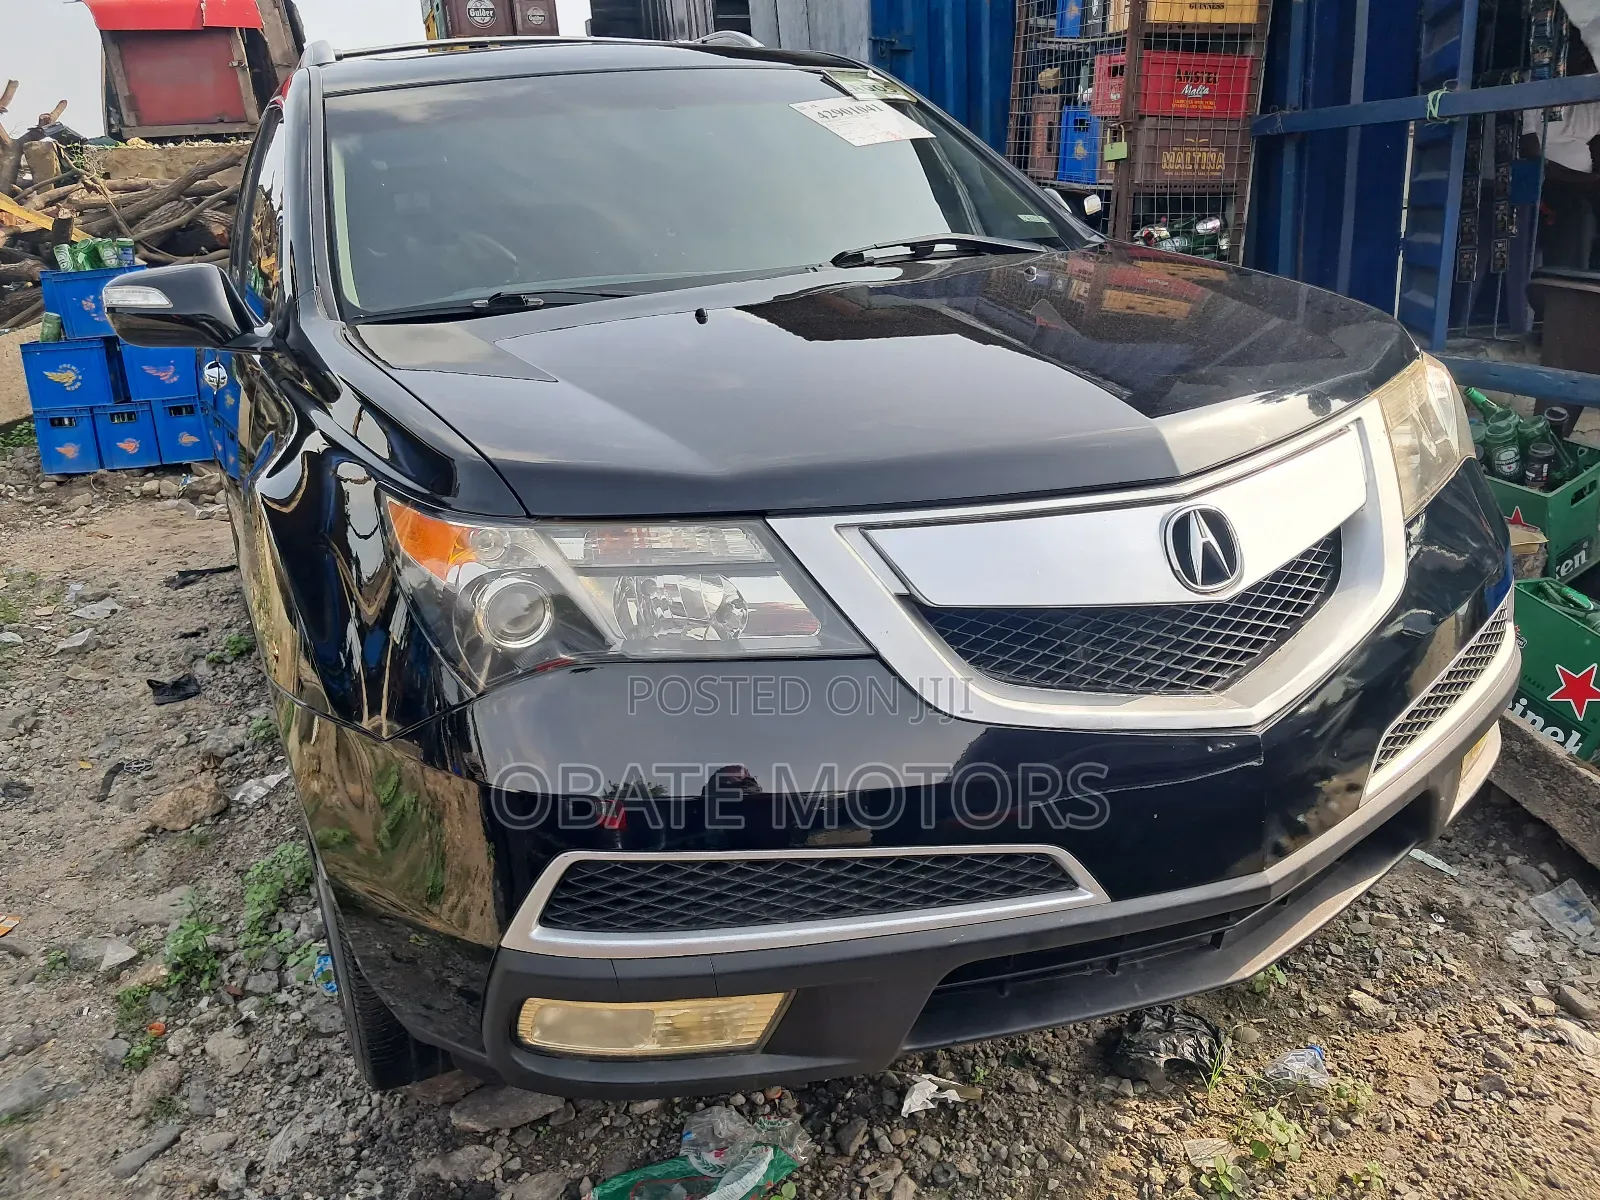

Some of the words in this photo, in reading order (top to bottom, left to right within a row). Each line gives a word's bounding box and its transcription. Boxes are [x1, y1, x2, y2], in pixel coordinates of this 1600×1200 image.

[469, 8, 494, 17] Gulder
[1189, 2, 1225, 10] GUINNESS
[1174, 68, 1219, 85] AMSTEL
[1181, 84, 1210, 96] Malta
[817, 103, 884, 120] 42901041
[1161, 151, 1226, 169] MALTINA
[1507, 697, 1583, 755] inek
